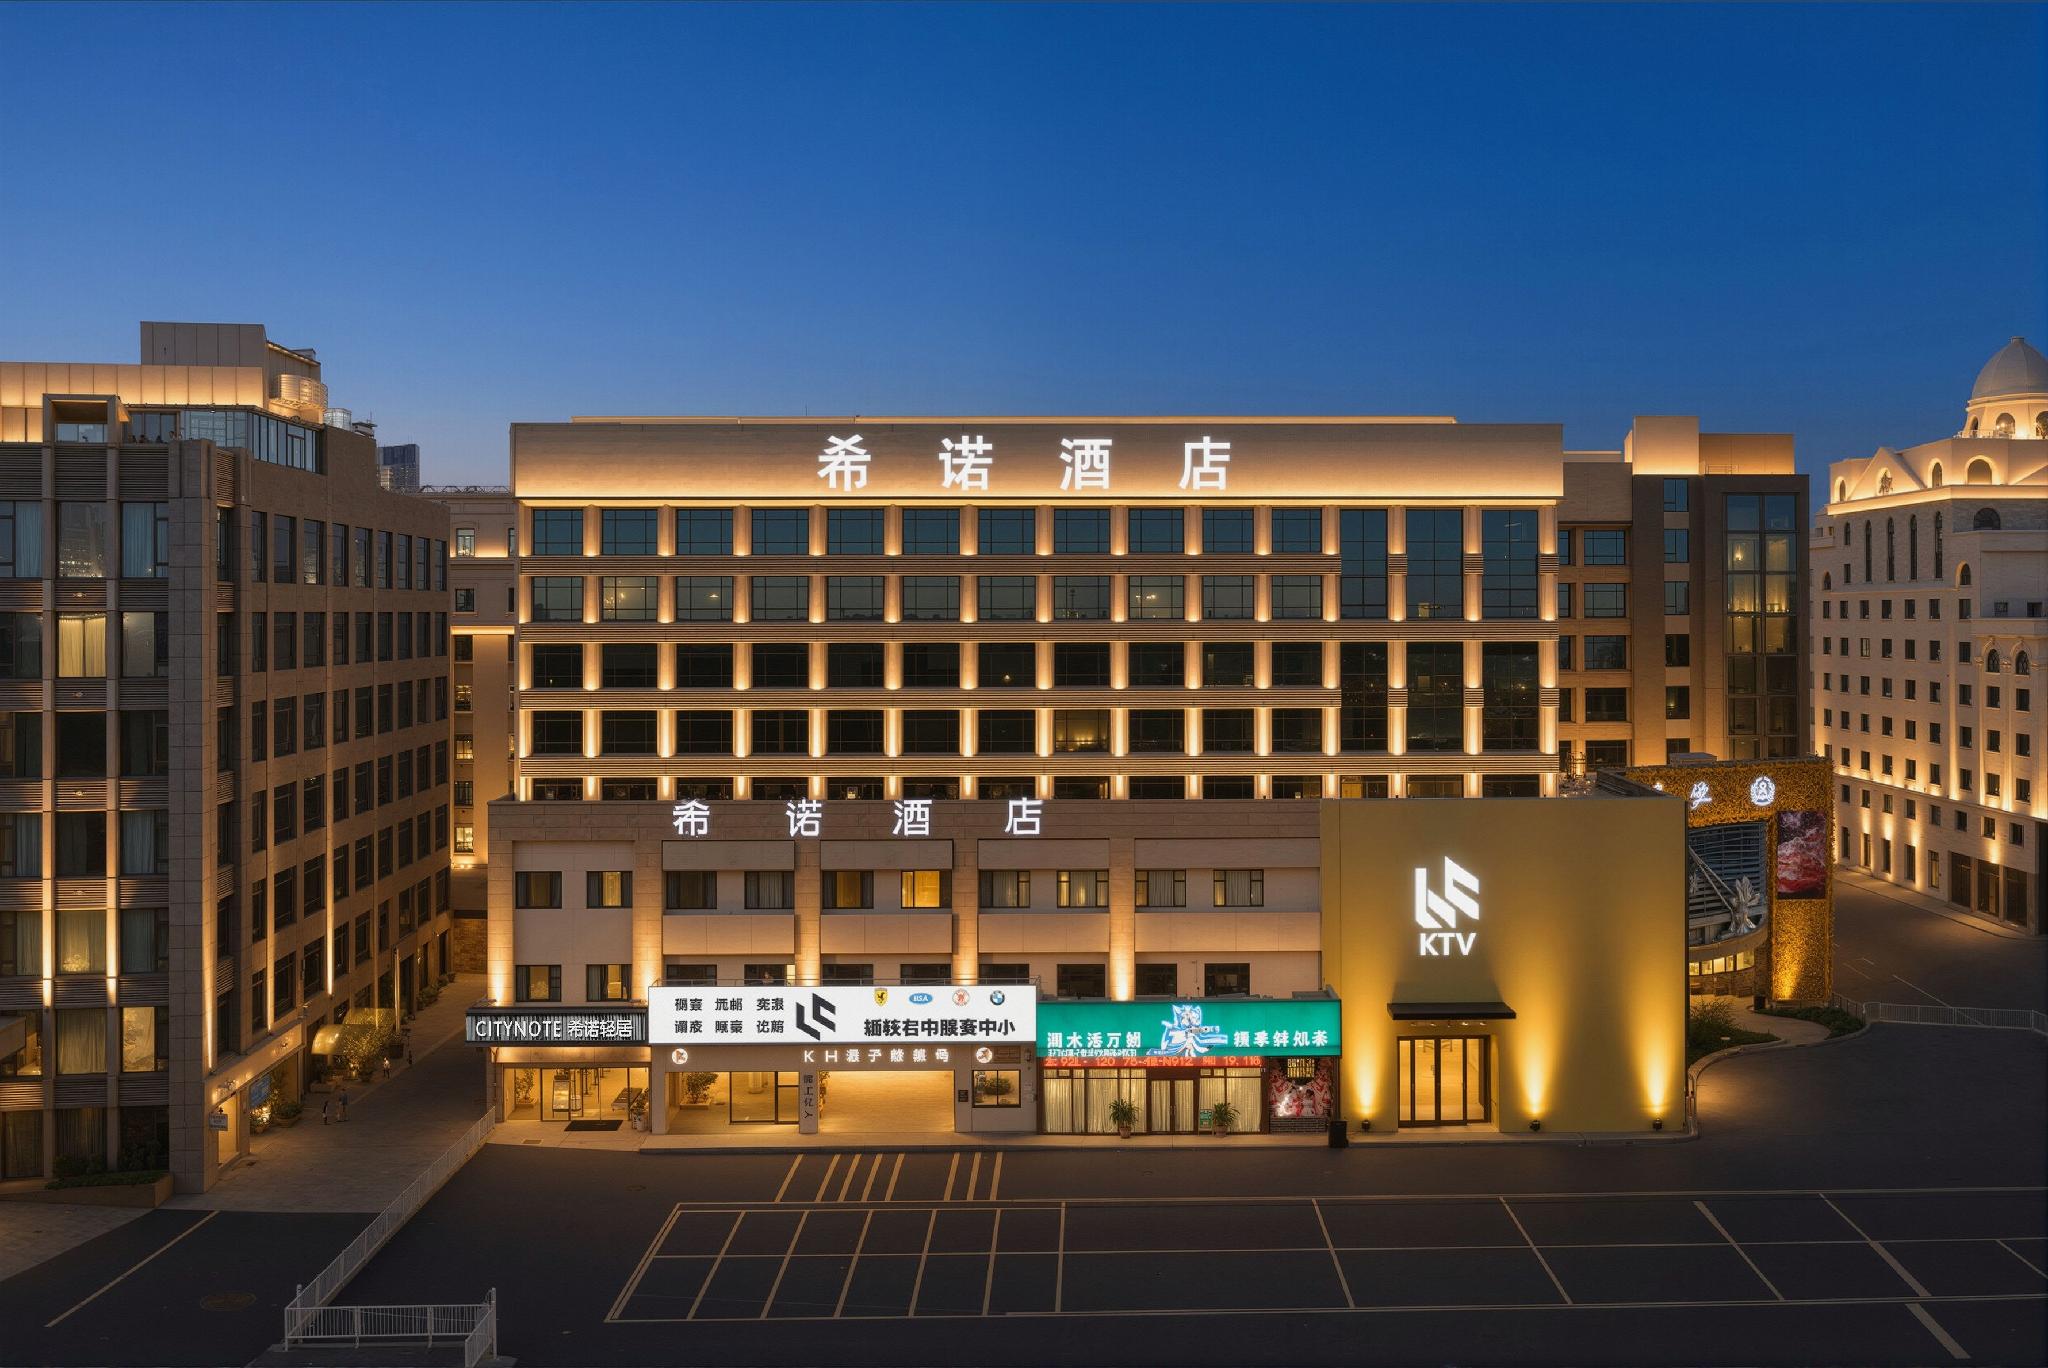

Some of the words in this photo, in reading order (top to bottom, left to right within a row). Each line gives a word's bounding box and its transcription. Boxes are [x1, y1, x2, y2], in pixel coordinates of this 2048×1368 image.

[817, 434, 1231, 491] 希诺酒店
[672, 797, 1043, 838] 希诺酒店
[1420, 932, 1477, 956] KTV
[475, 1020, 561, 1038] CITYNOTE
[568, 1019, 634, 1038] 希诺轻居
